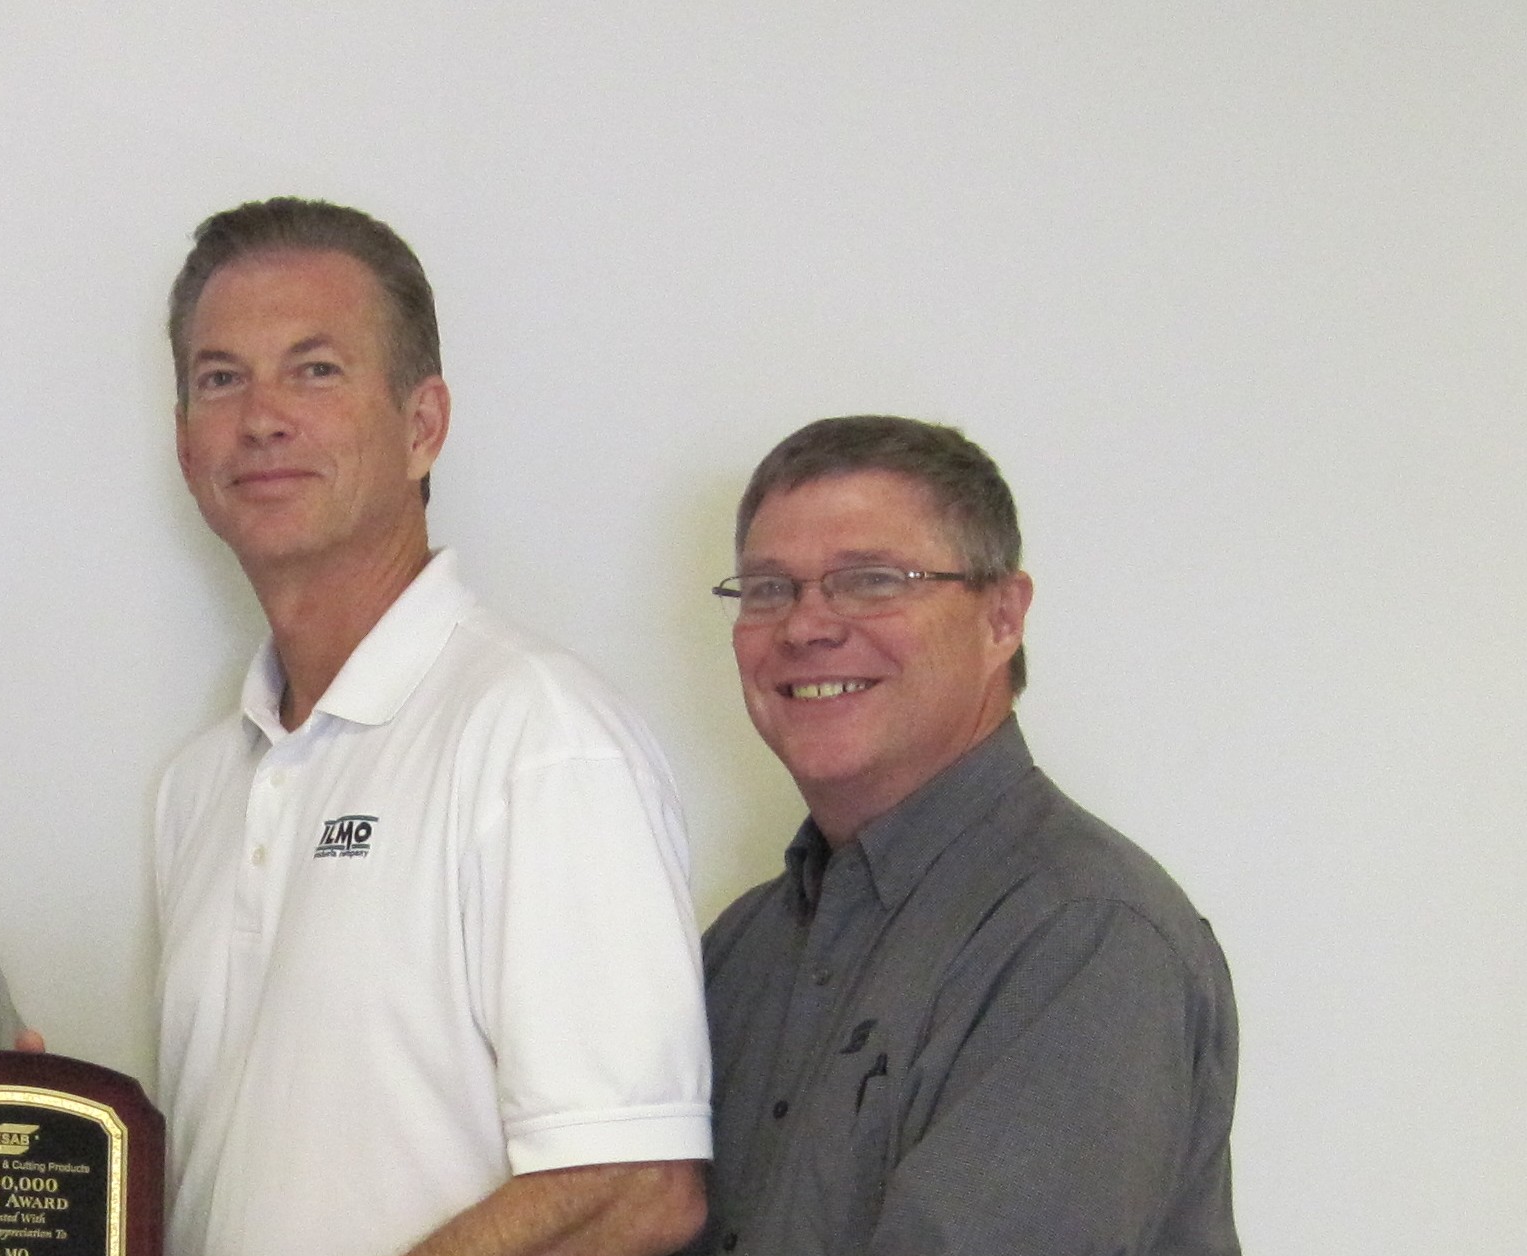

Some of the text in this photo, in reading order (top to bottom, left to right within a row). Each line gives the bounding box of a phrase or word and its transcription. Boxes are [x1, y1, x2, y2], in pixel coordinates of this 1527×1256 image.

[319, 820, 372, 850] ILMO
[3, 1159, 10, 1170] &
[12, 1160, 46, 1173] Cutting
[48, 1162, 91, 1174] Products
[21, 1212, 46, 1225] With
[55, 1228, 68, 1240] To
